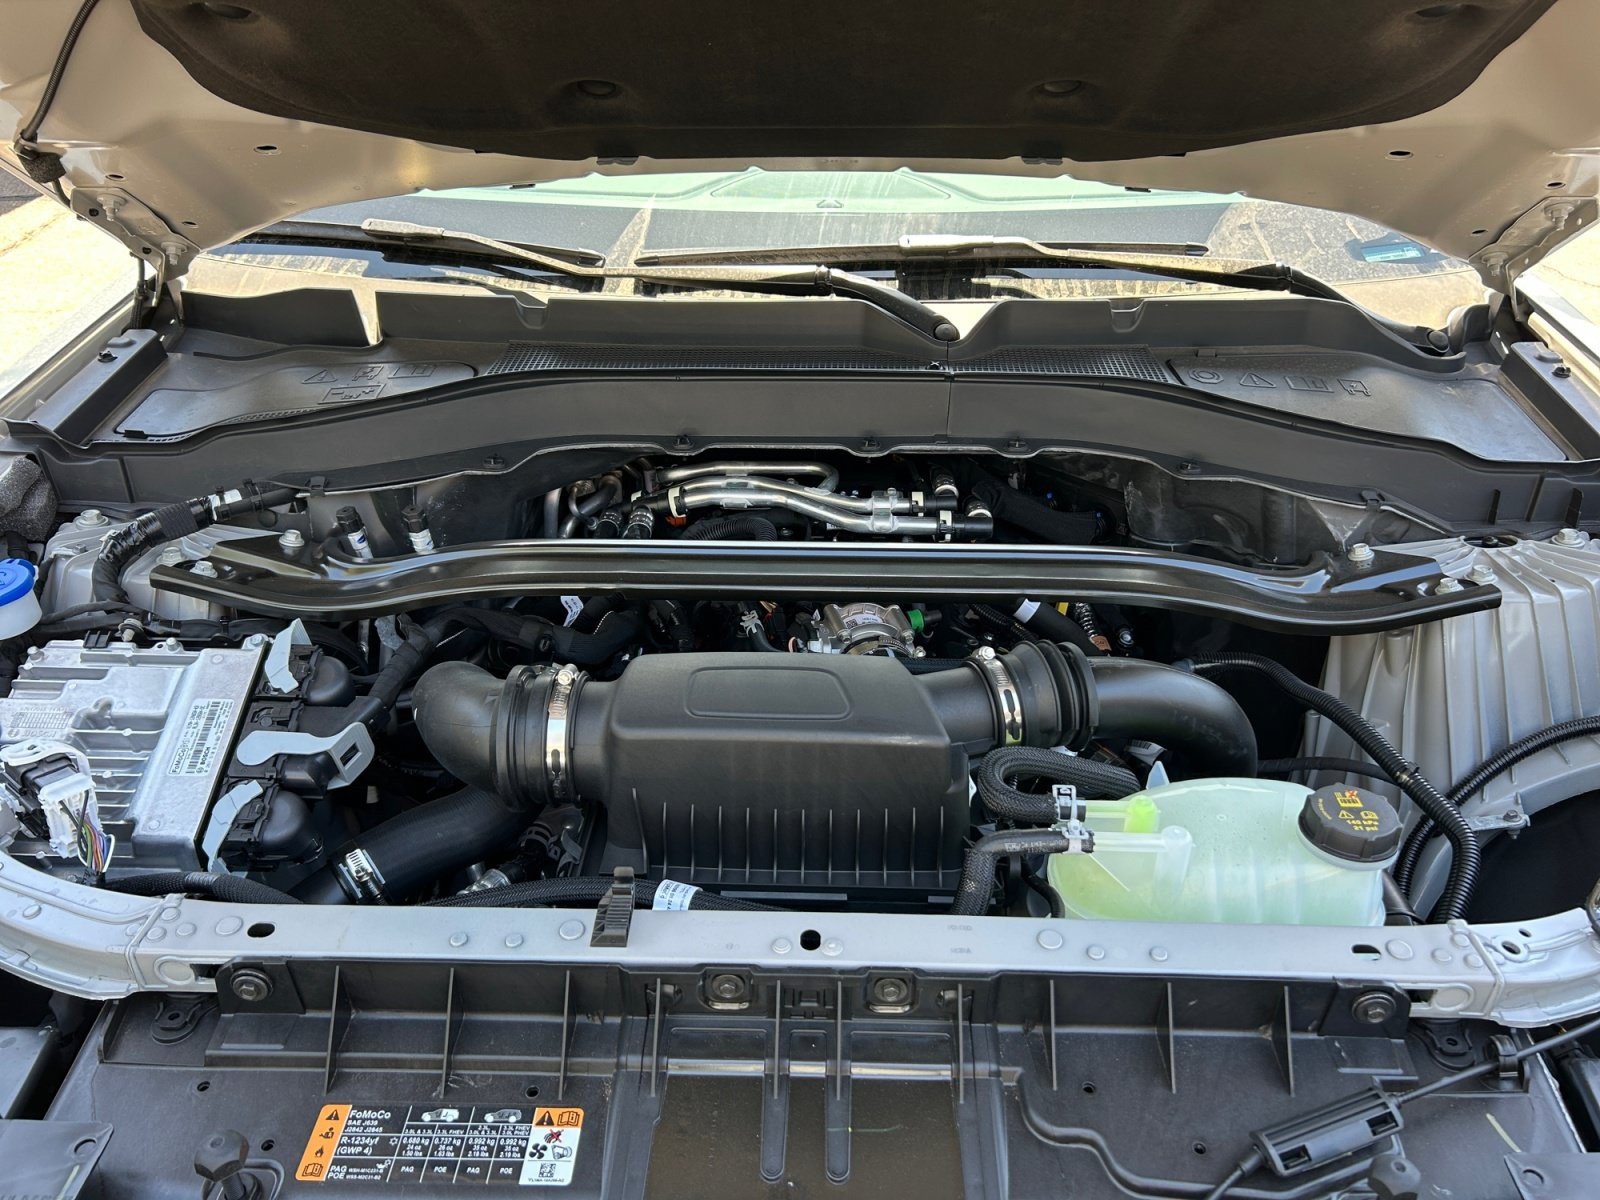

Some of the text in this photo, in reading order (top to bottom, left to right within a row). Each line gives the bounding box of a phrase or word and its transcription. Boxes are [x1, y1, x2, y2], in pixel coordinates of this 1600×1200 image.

[200, 746, 211, 765] BOSCH
[172, 749, 186, 773] FoMoCo
[349, 1109, 391, 1119] FoMoCo
[340, 1136, 380, 1146] R-1234yf
[336, 1146, 373, 1156] (GWP 4)
